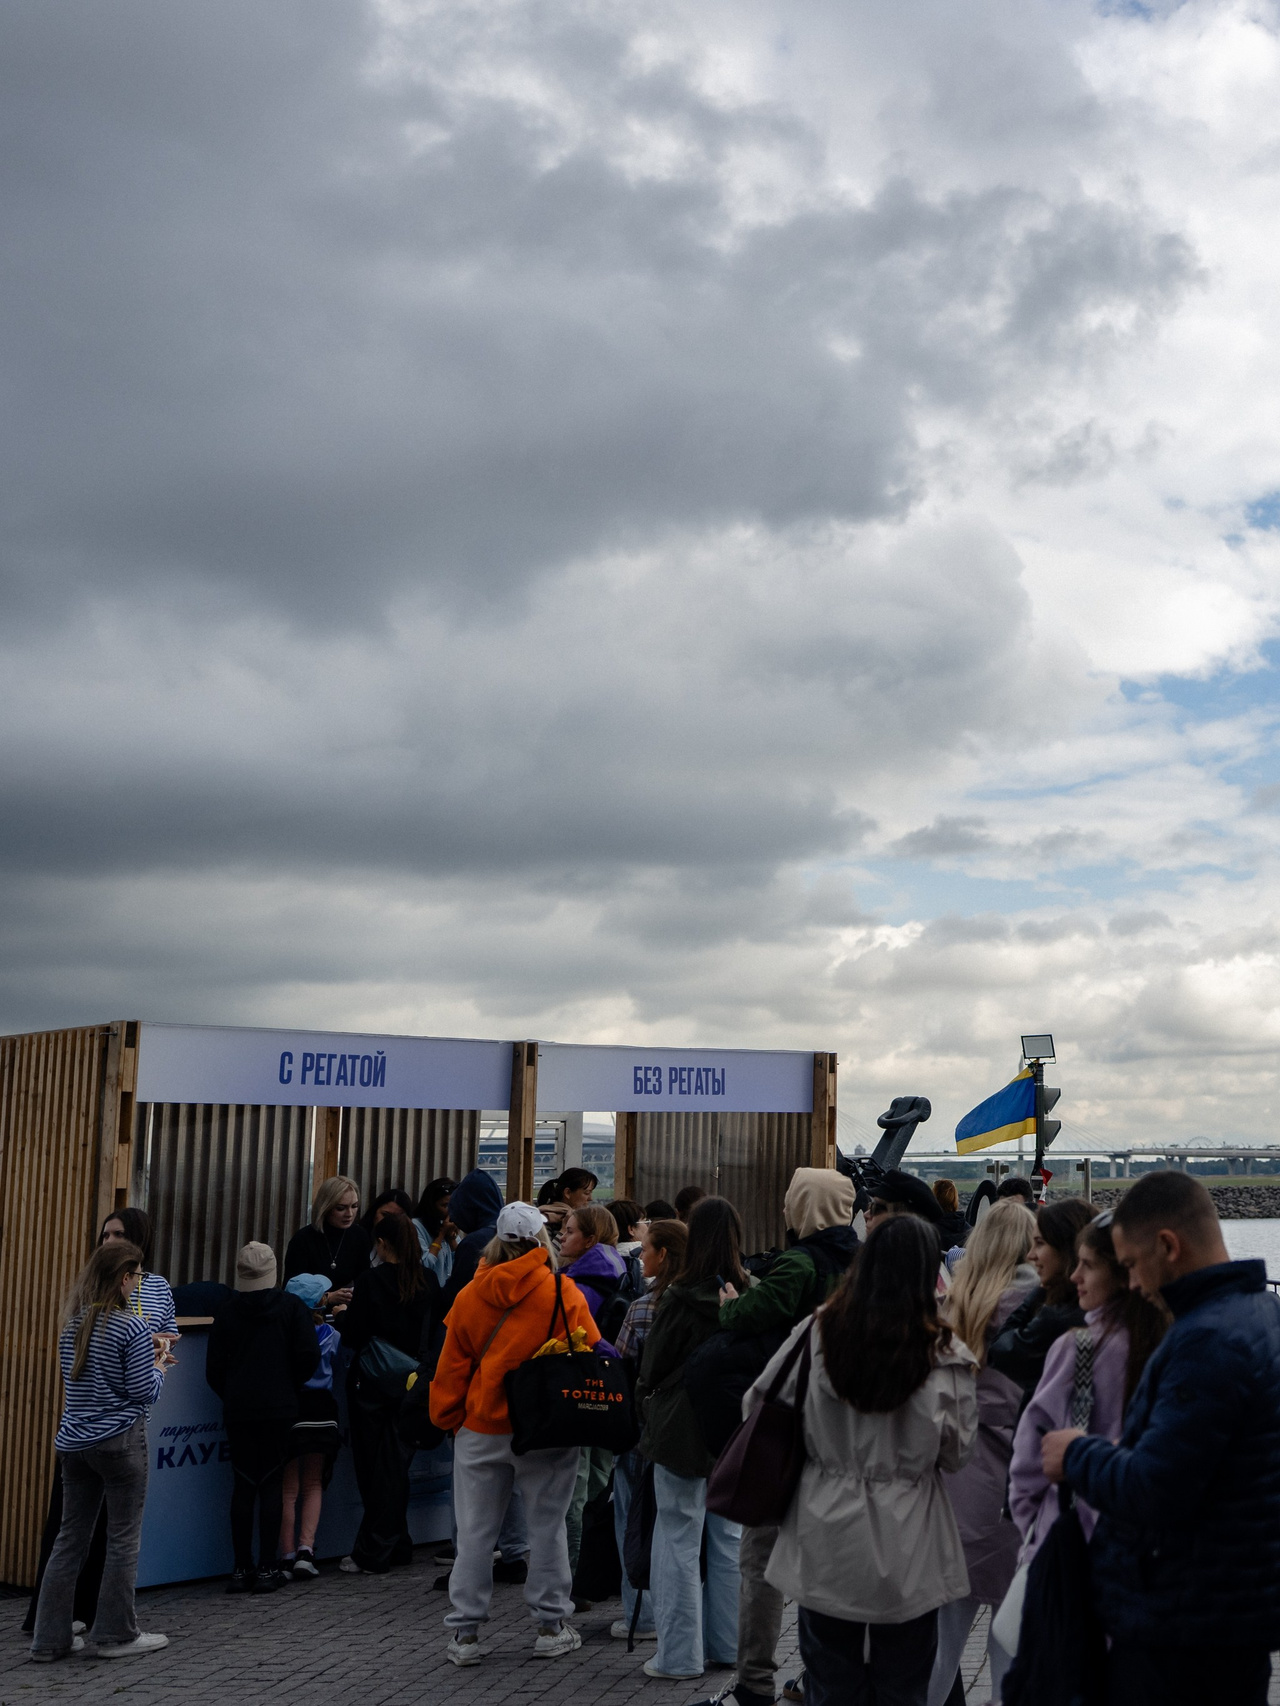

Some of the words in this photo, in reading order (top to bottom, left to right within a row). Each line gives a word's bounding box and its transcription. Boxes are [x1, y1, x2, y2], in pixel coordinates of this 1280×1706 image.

[278, 1051, 294, 1085] С
[300, 1050, 388, 1087] РЕГАТОЙ
[633, 1065, 663, 1096] БЕЗ
[668, 1066, 727, 1096] РЕГАТЫ
[585, 1378, 604, 1388] THE
